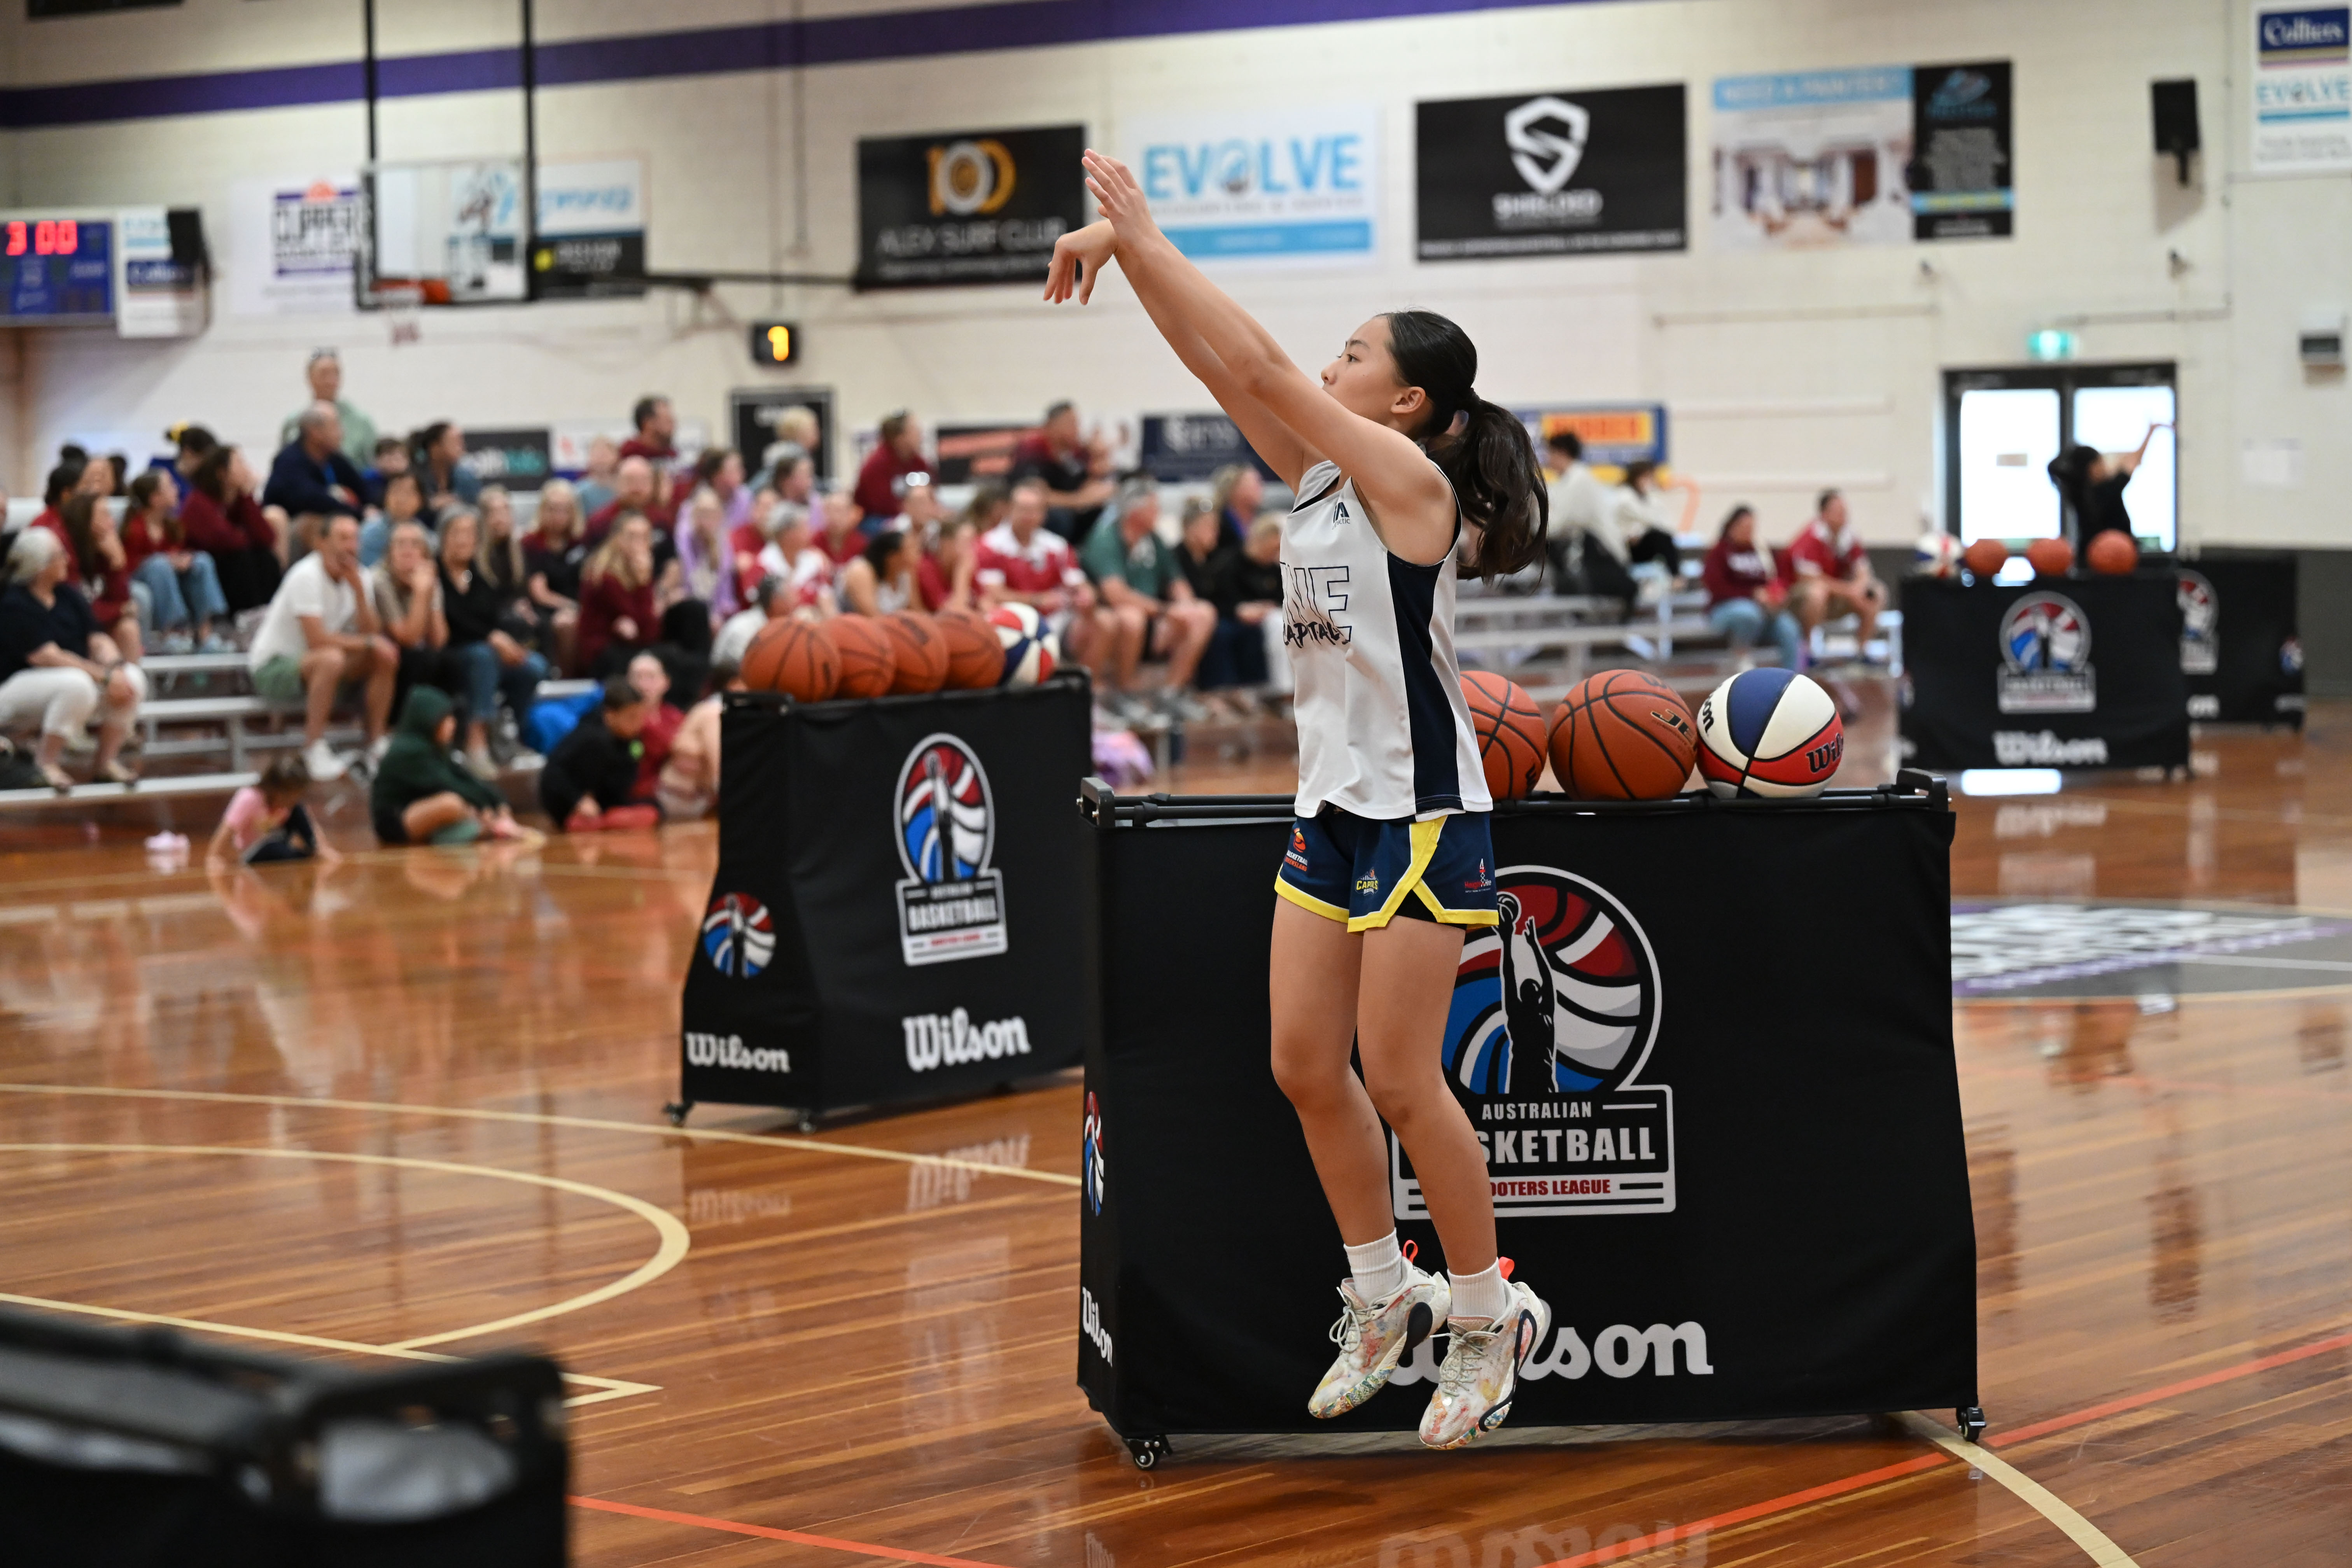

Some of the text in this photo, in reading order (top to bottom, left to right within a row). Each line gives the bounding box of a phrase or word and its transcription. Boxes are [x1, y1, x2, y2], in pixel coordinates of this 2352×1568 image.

[2264, 17, 2344, 46] Colliers
[2257, 75, 2350, 104] EVOLVE
[1143, 133, 1362, 199] EVOLVE
[938, 222, 997, 254] SURF
[998, 216, 1069, 251] CLUB
[1992, 730, 2109, 765] Wilson
[908, 895, 996, 932] BASKETBALL
[684, 1032, 791, 1073] Wilson
[901, 1006, 1032, 1073] Wilson
[1482, 1101, 1592, 1120] AUSTRALIAN
[1476, 1127, 1656, 1165] SKETBALL
[1552, 1179, 1611, 1195] LEAGUE
[1082, 1286, 1113, 1368] Wilson
